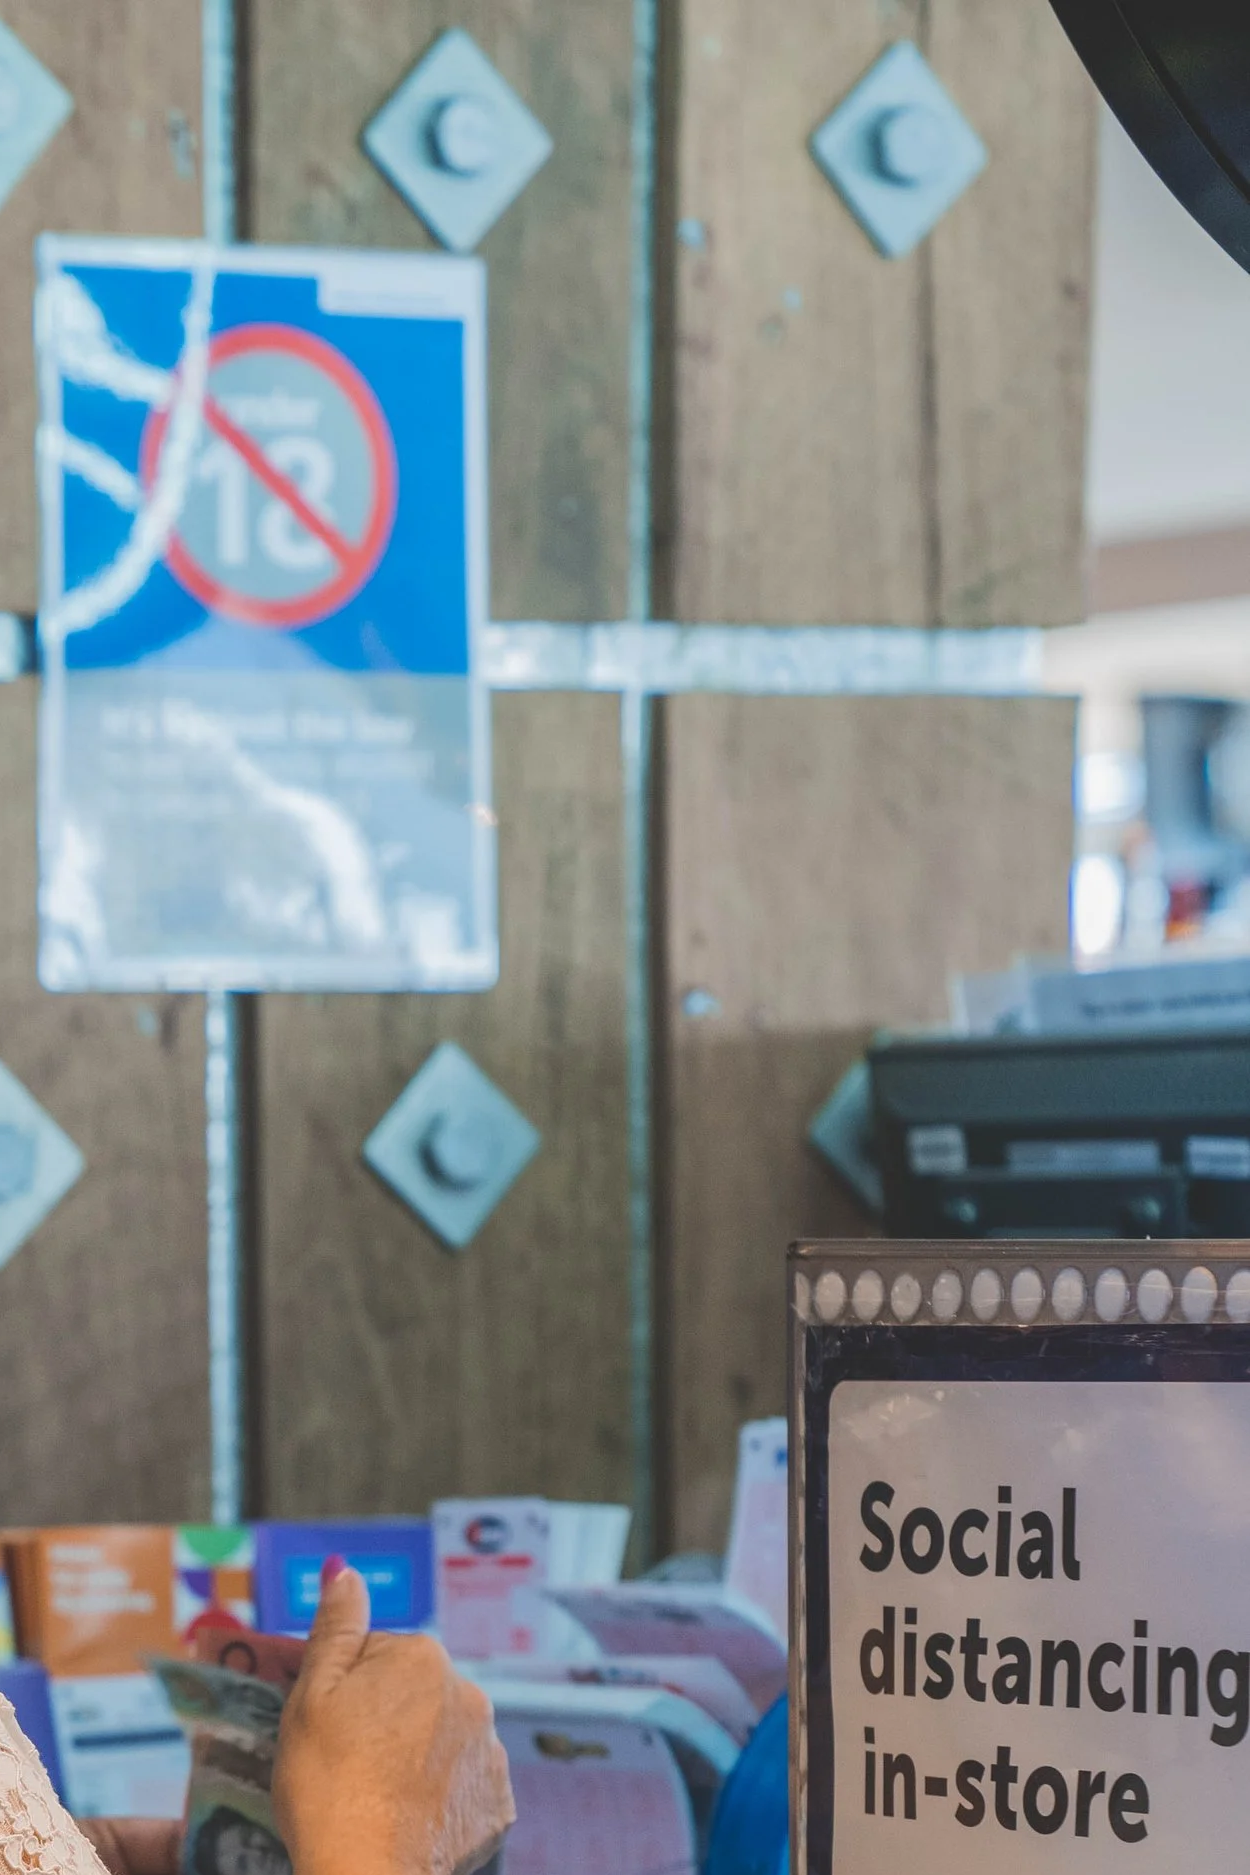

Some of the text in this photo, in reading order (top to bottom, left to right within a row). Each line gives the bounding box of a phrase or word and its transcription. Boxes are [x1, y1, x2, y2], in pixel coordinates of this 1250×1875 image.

[199, 437, 338, 571] 18
[859, 1480, 1081, 1581] Social
[859, 1605, 1250, 1747] distancing
[863, 1726, 1149, 1843] in-store
